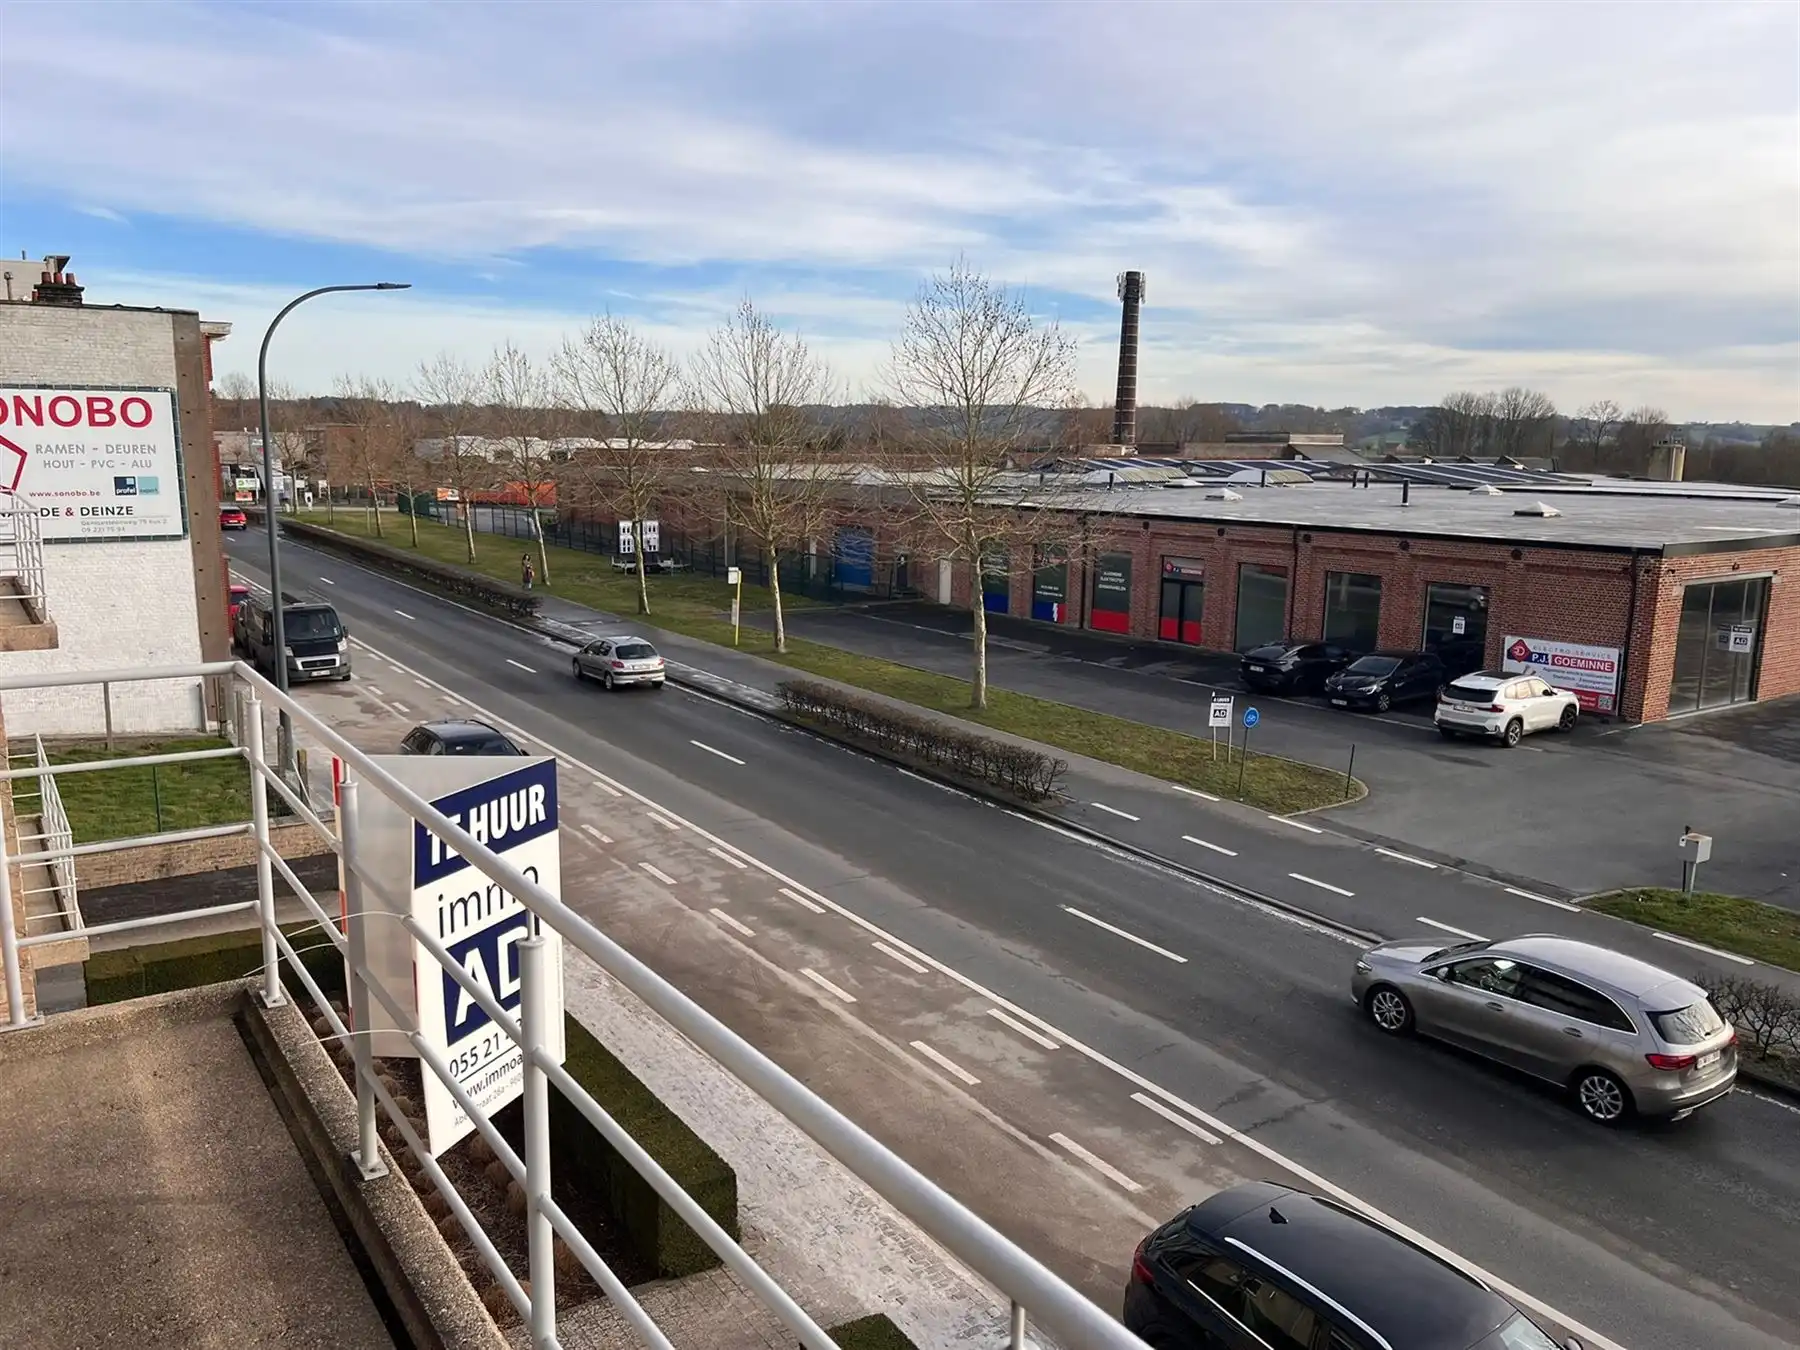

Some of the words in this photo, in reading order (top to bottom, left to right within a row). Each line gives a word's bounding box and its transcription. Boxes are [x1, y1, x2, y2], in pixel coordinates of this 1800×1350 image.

[0, 395, 153, 428] NOBO
[35, 444, 86, 455] RAMEN
[105, 444, 157, 455] DEUREN
[43, 459, 75, 469] HOUT
[91, 459, 115, 469] PVC
[131, 459, 152, 469] ALU
[65, 507, 75, 517] &
[80, 506, 134, 517] DEINZE
[1554, 656, 1613, 672] GOEMINNE
[469, 783, 547, 846] HUUR
[449, 1045, 479, 1078] 055
[482, 1032, 500, 1059] 21
